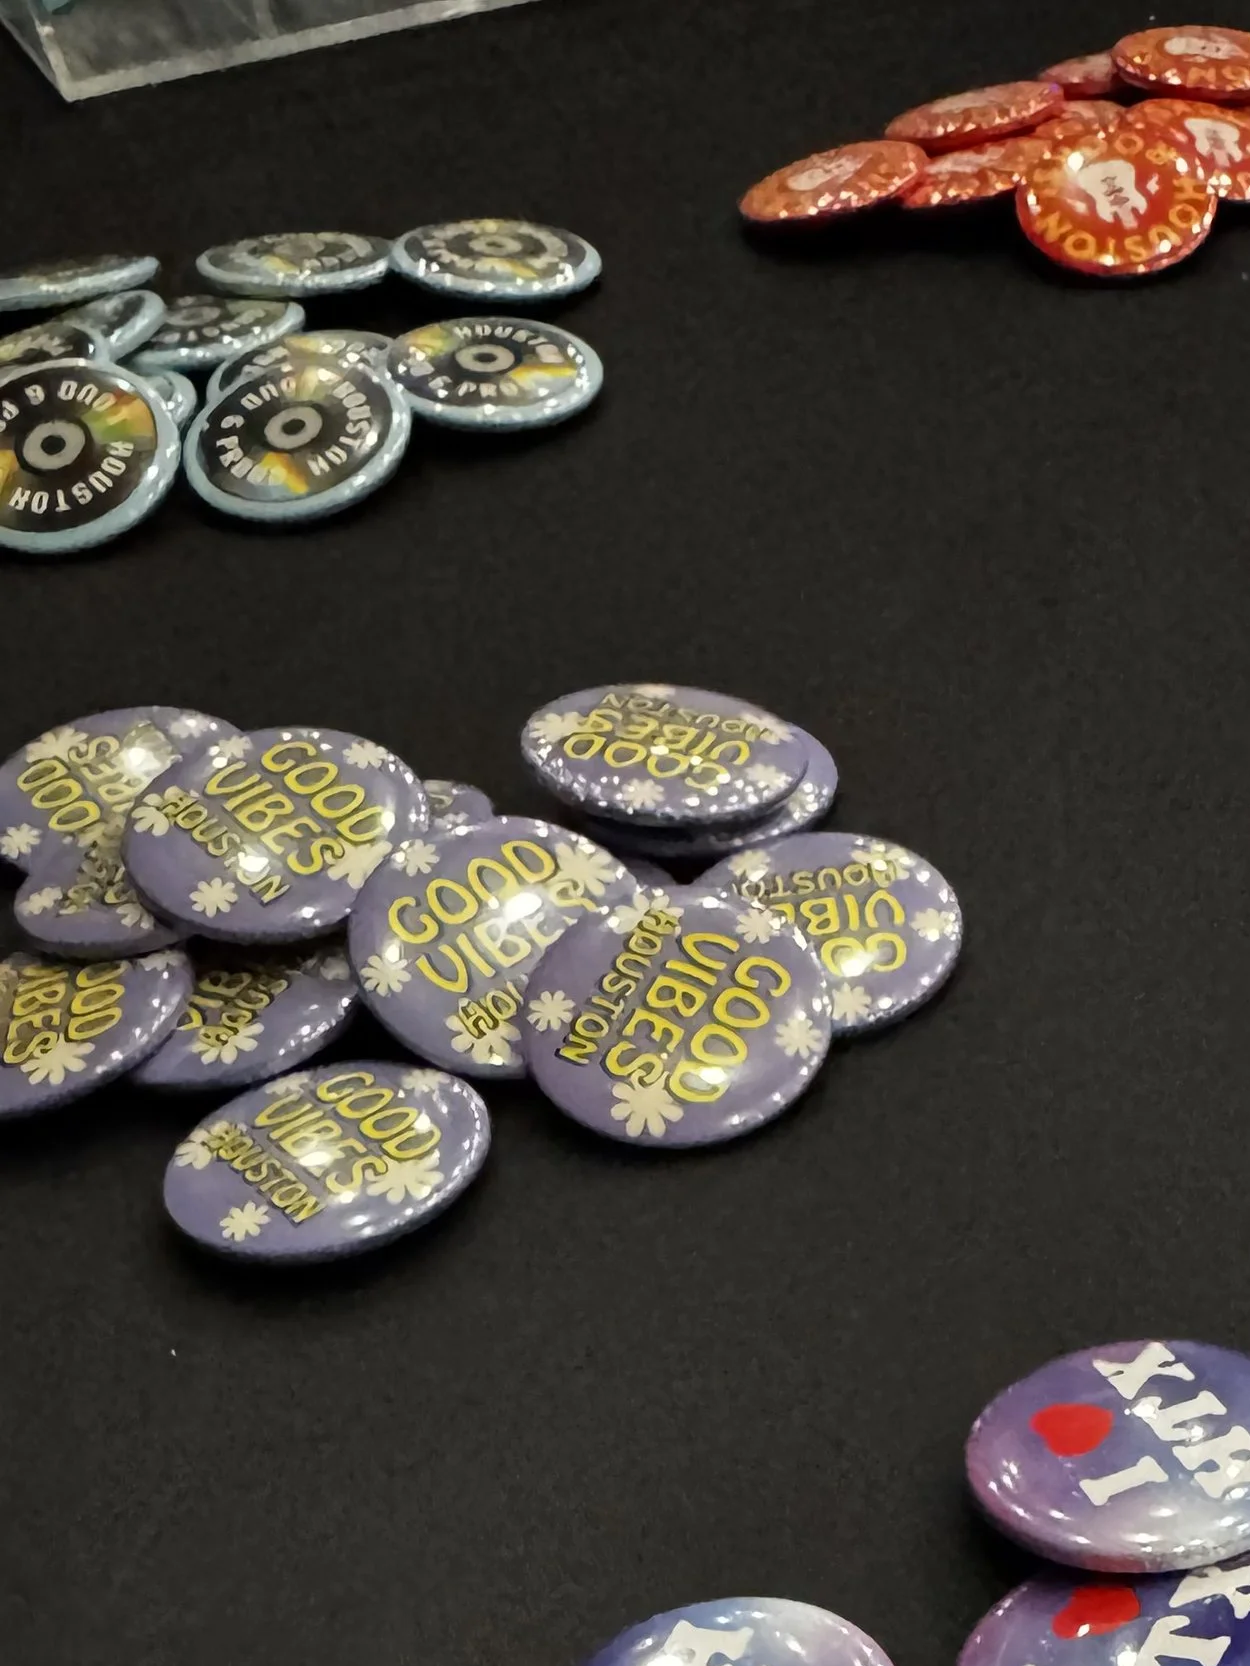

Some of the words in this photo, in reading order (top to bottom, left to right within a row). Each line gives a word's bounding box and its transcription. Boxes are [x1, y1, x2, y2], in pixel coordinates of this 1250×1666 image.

[8, 440, 135, 515] HOUSTON
[563, 733, 731, 791] GOOD
[580, 707, 750, 765] VIBES
[204, 761, 346, 876] VIBES
[260, 741, 396, 843] GOOD
[388, 840, 556, 945] GOOD
[732, 860, 902, 898] HOUSTO
[769, 889, 906, 936] VIB
[415, 880, 597, 994] VIBES
[820, 932, 908, 978] GO
[67, 961, 133, 1041] OOD
[555, 908, 682, 1066] HOUSTON
[604, 932, 740, 1087] VIBES
[669, 956, 792, 1103] GOOD
[254, 1093, 389, 1194] VIBES
[316, 1071, 442, 1160] GOOD
[208, 1122, 328, 1226] HOUSTON
[1079, 1456, 1169, 1506] I
